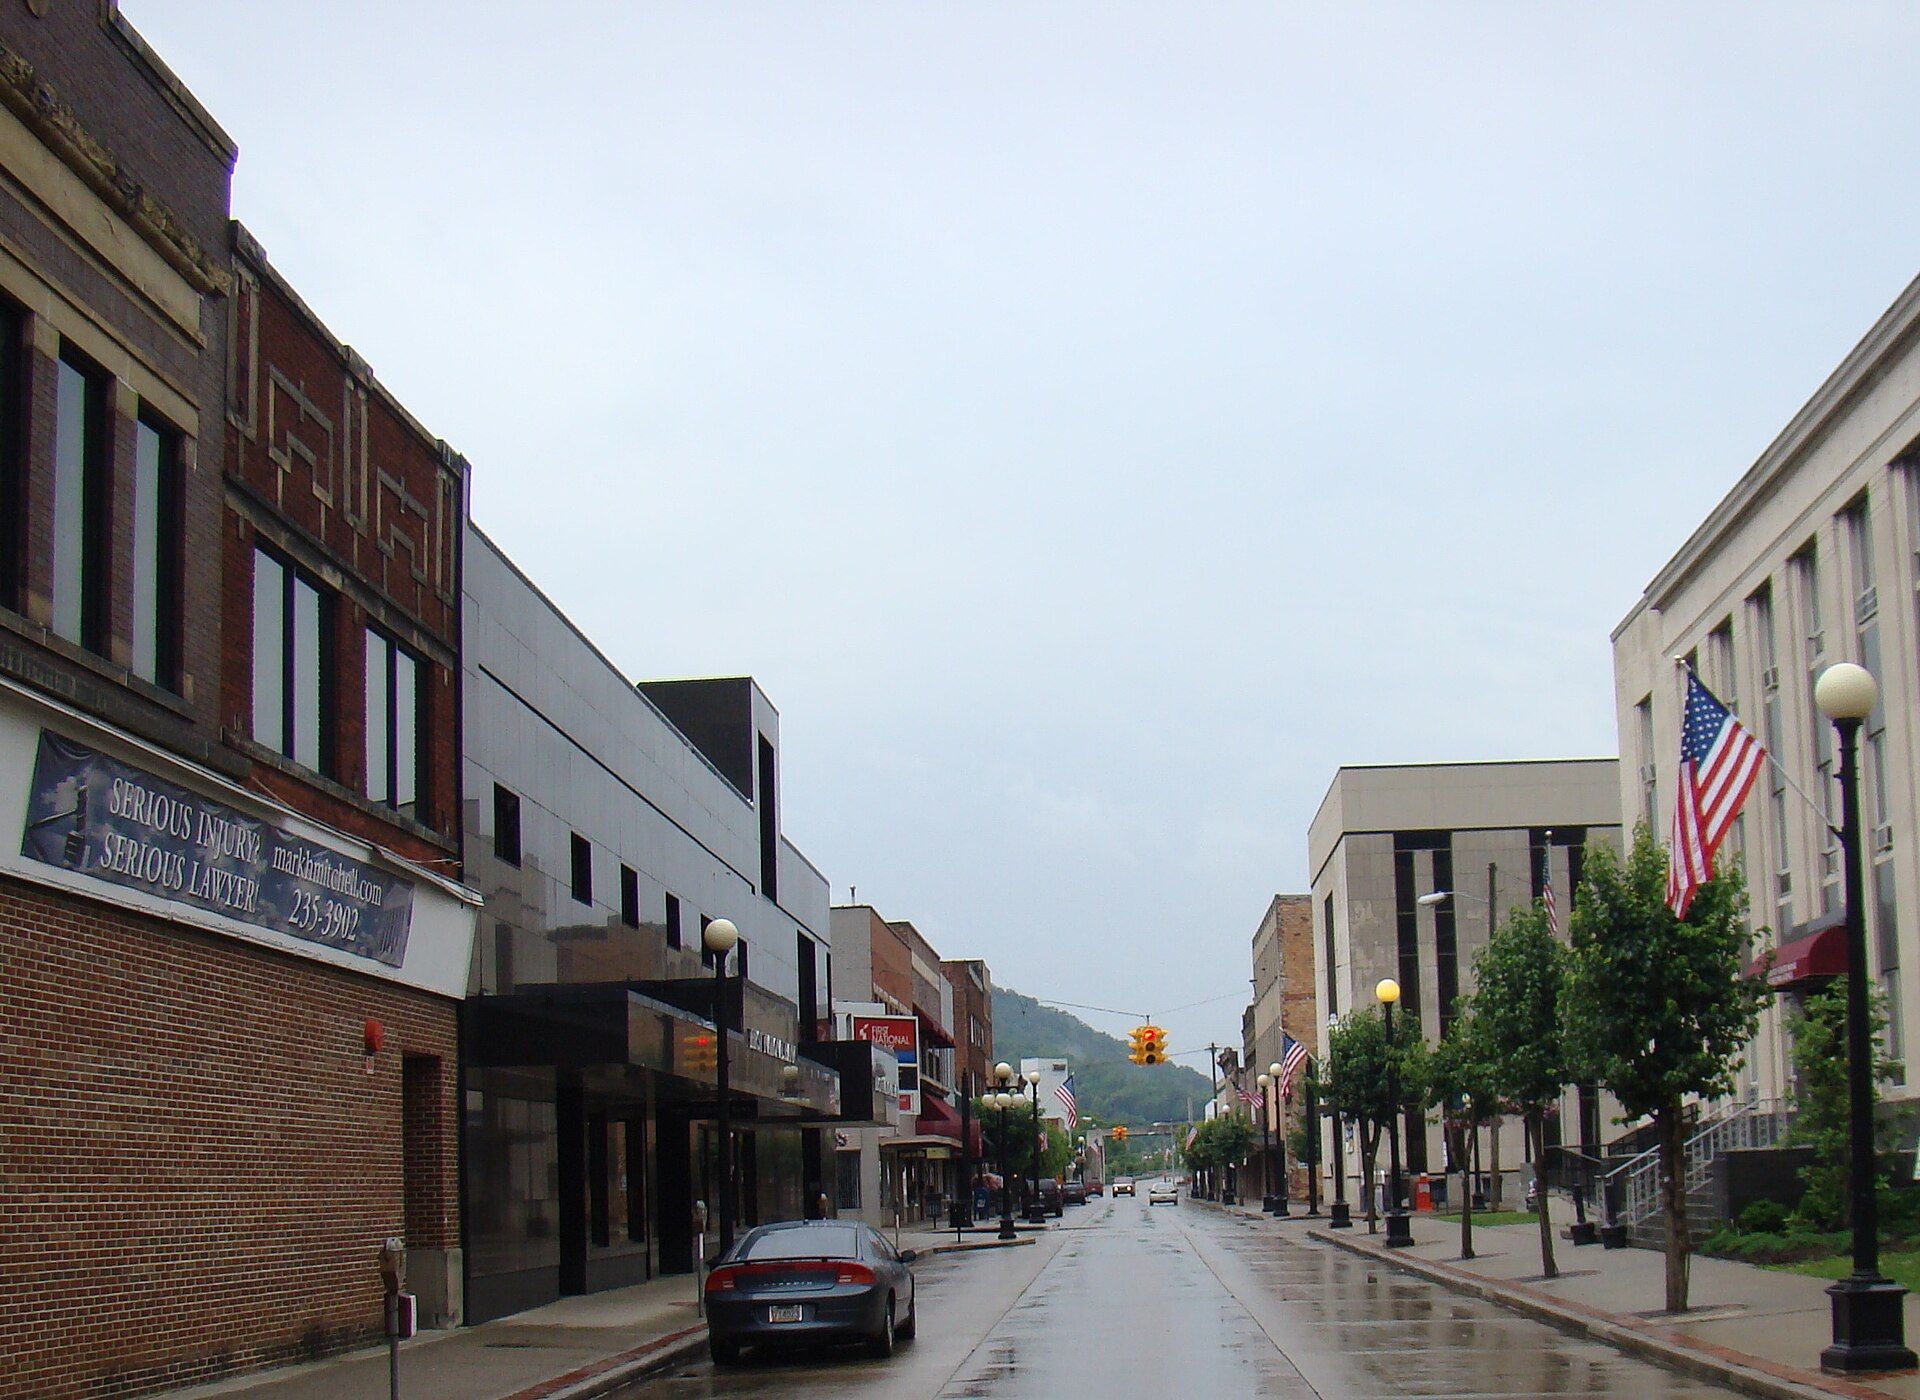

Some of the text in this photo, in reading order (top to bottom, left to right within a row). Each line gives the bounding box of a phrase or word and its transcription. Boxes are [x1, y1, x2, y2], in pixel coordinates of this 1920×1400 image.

[110, 777, 261, 865] SERIOUS INJURY?
[100, 832, 259, 913] SERIOUS LAWYER!
[272, 846, 382, 906] markhmitchell.com
[288, 888, 359, 941] 235-3902
[871, 1025, 889, 1034] FIRST
[871, 1033, 910, 1045] NATIONAL
